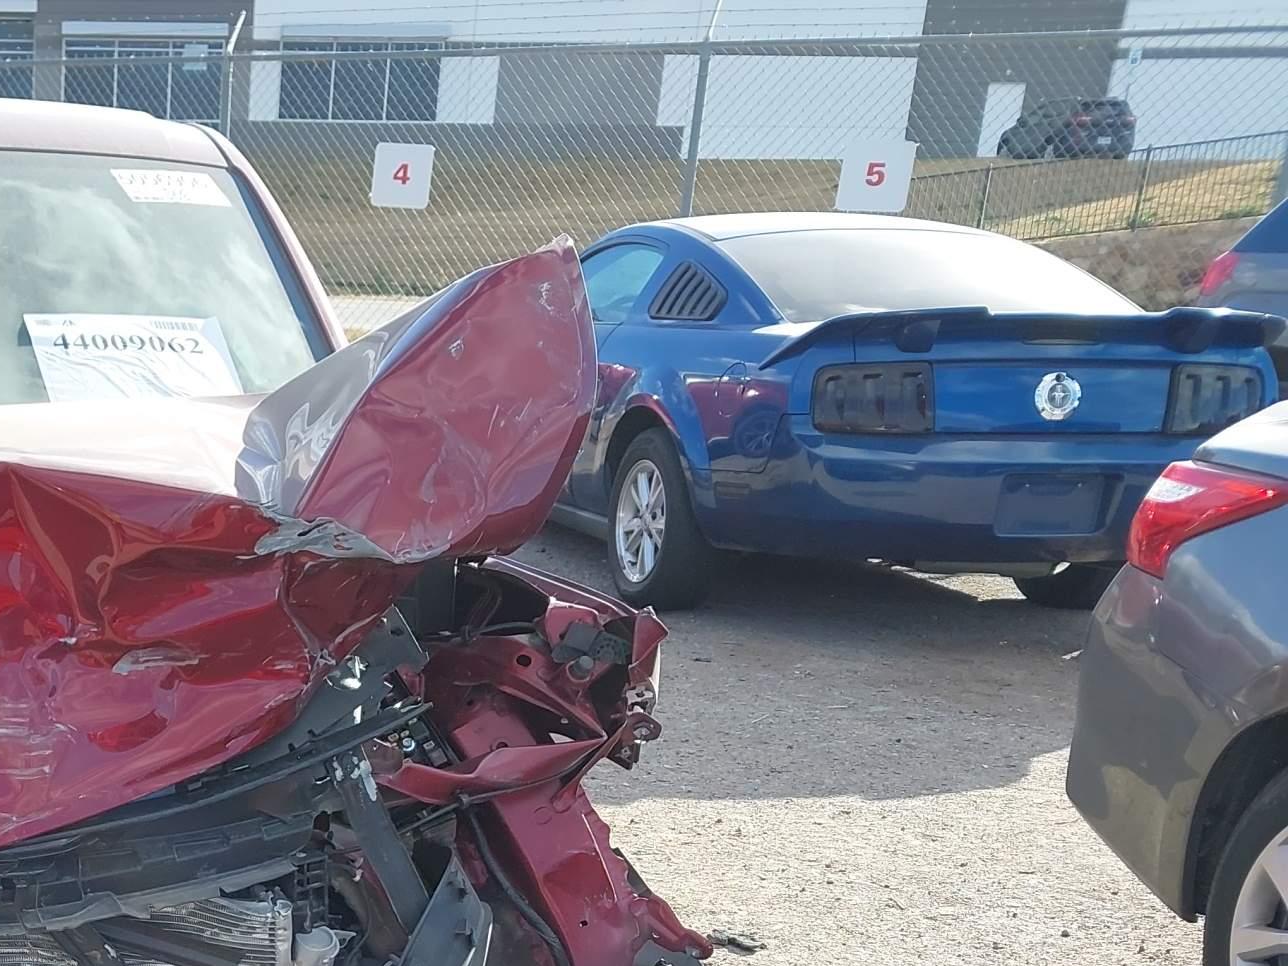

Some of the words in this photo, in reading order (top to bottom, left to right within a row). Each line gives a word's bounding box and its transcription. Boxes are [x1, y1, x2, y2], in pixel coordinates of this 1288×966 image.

[393, 163, 410, 184] 4
[866, 163, 886, 186] 5
[52, 331, 204, 355] 44009062
